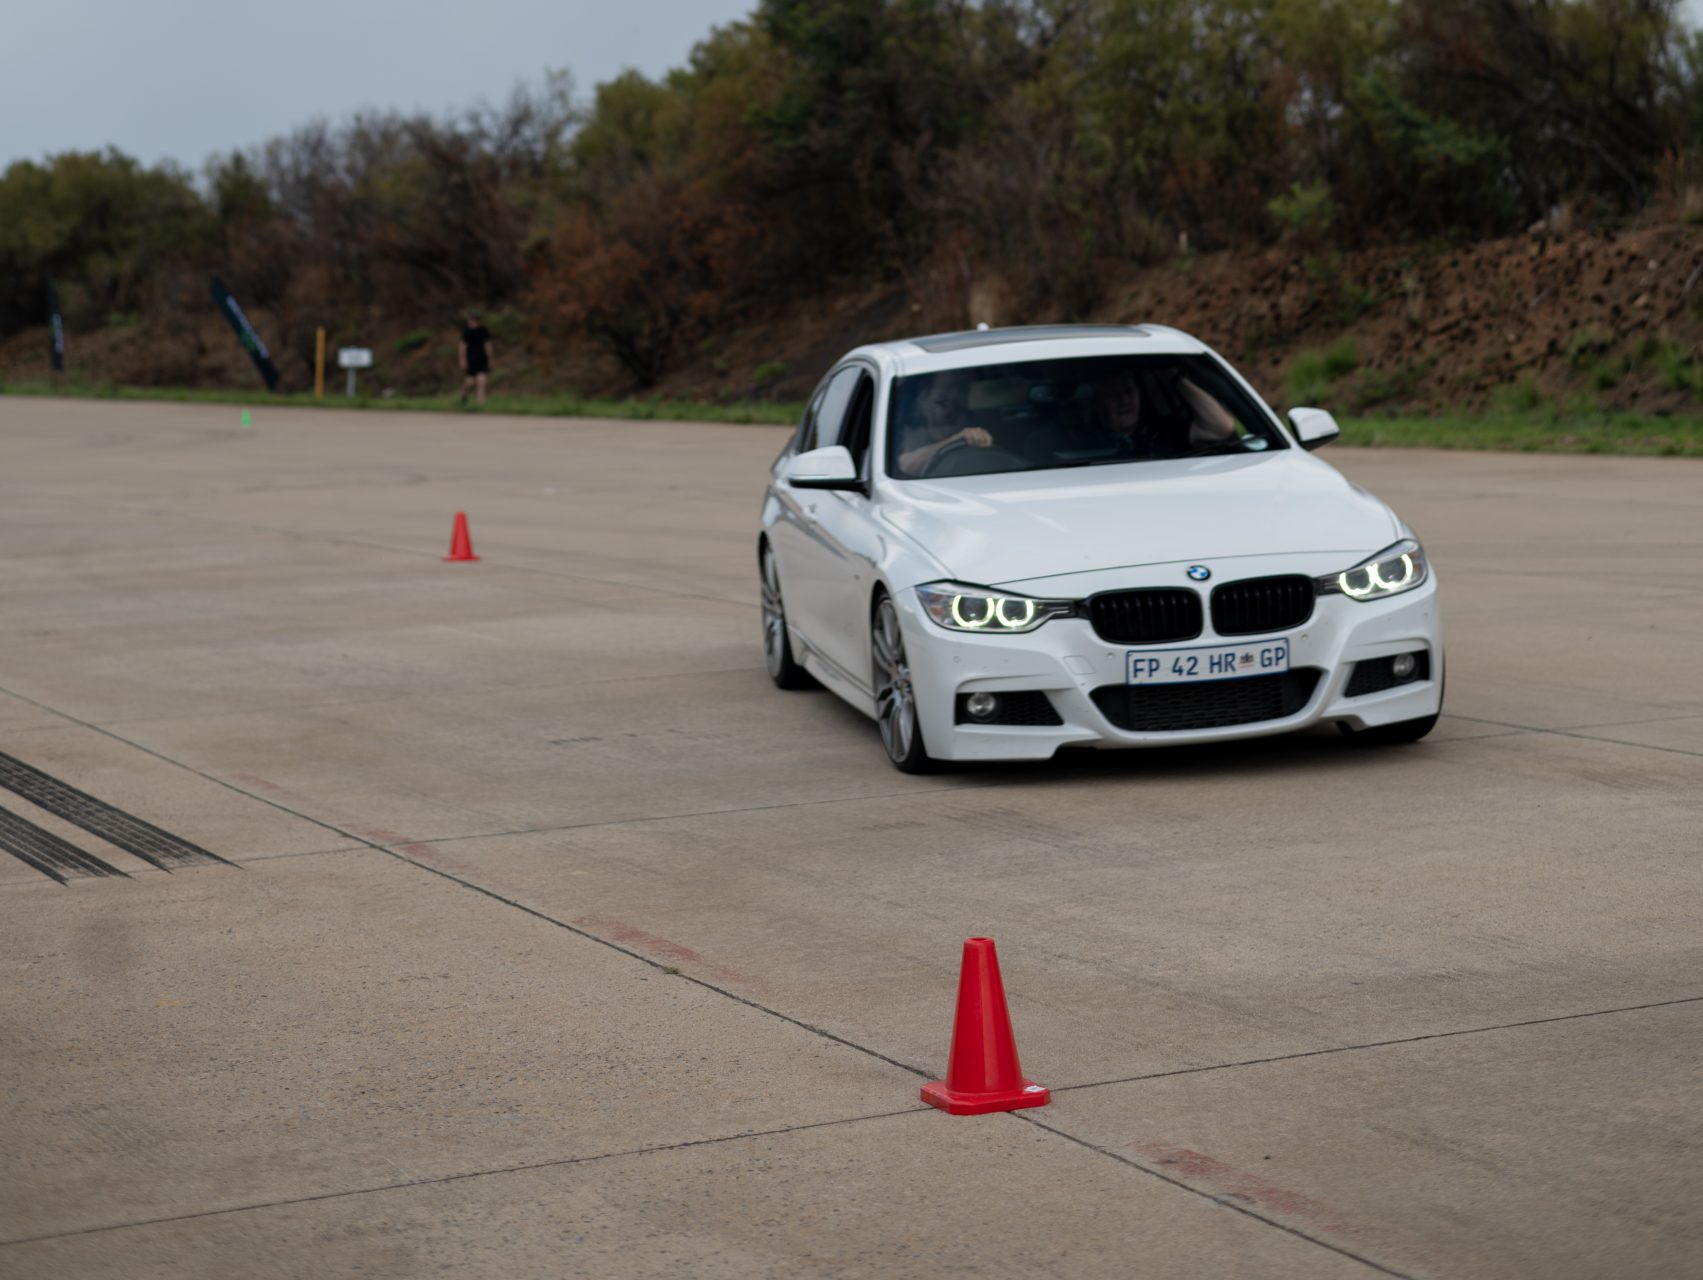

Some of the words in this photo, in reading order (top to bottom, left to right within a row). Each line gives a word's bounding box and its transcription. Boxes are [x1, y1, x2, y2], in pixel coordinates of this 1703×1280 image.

[1133, 659, 1160, 678] FP
[1172, 656, 1198, 676] 42
[1209, 653, 1236, 673] HR
[1260, 647, 1286, 668] GP
